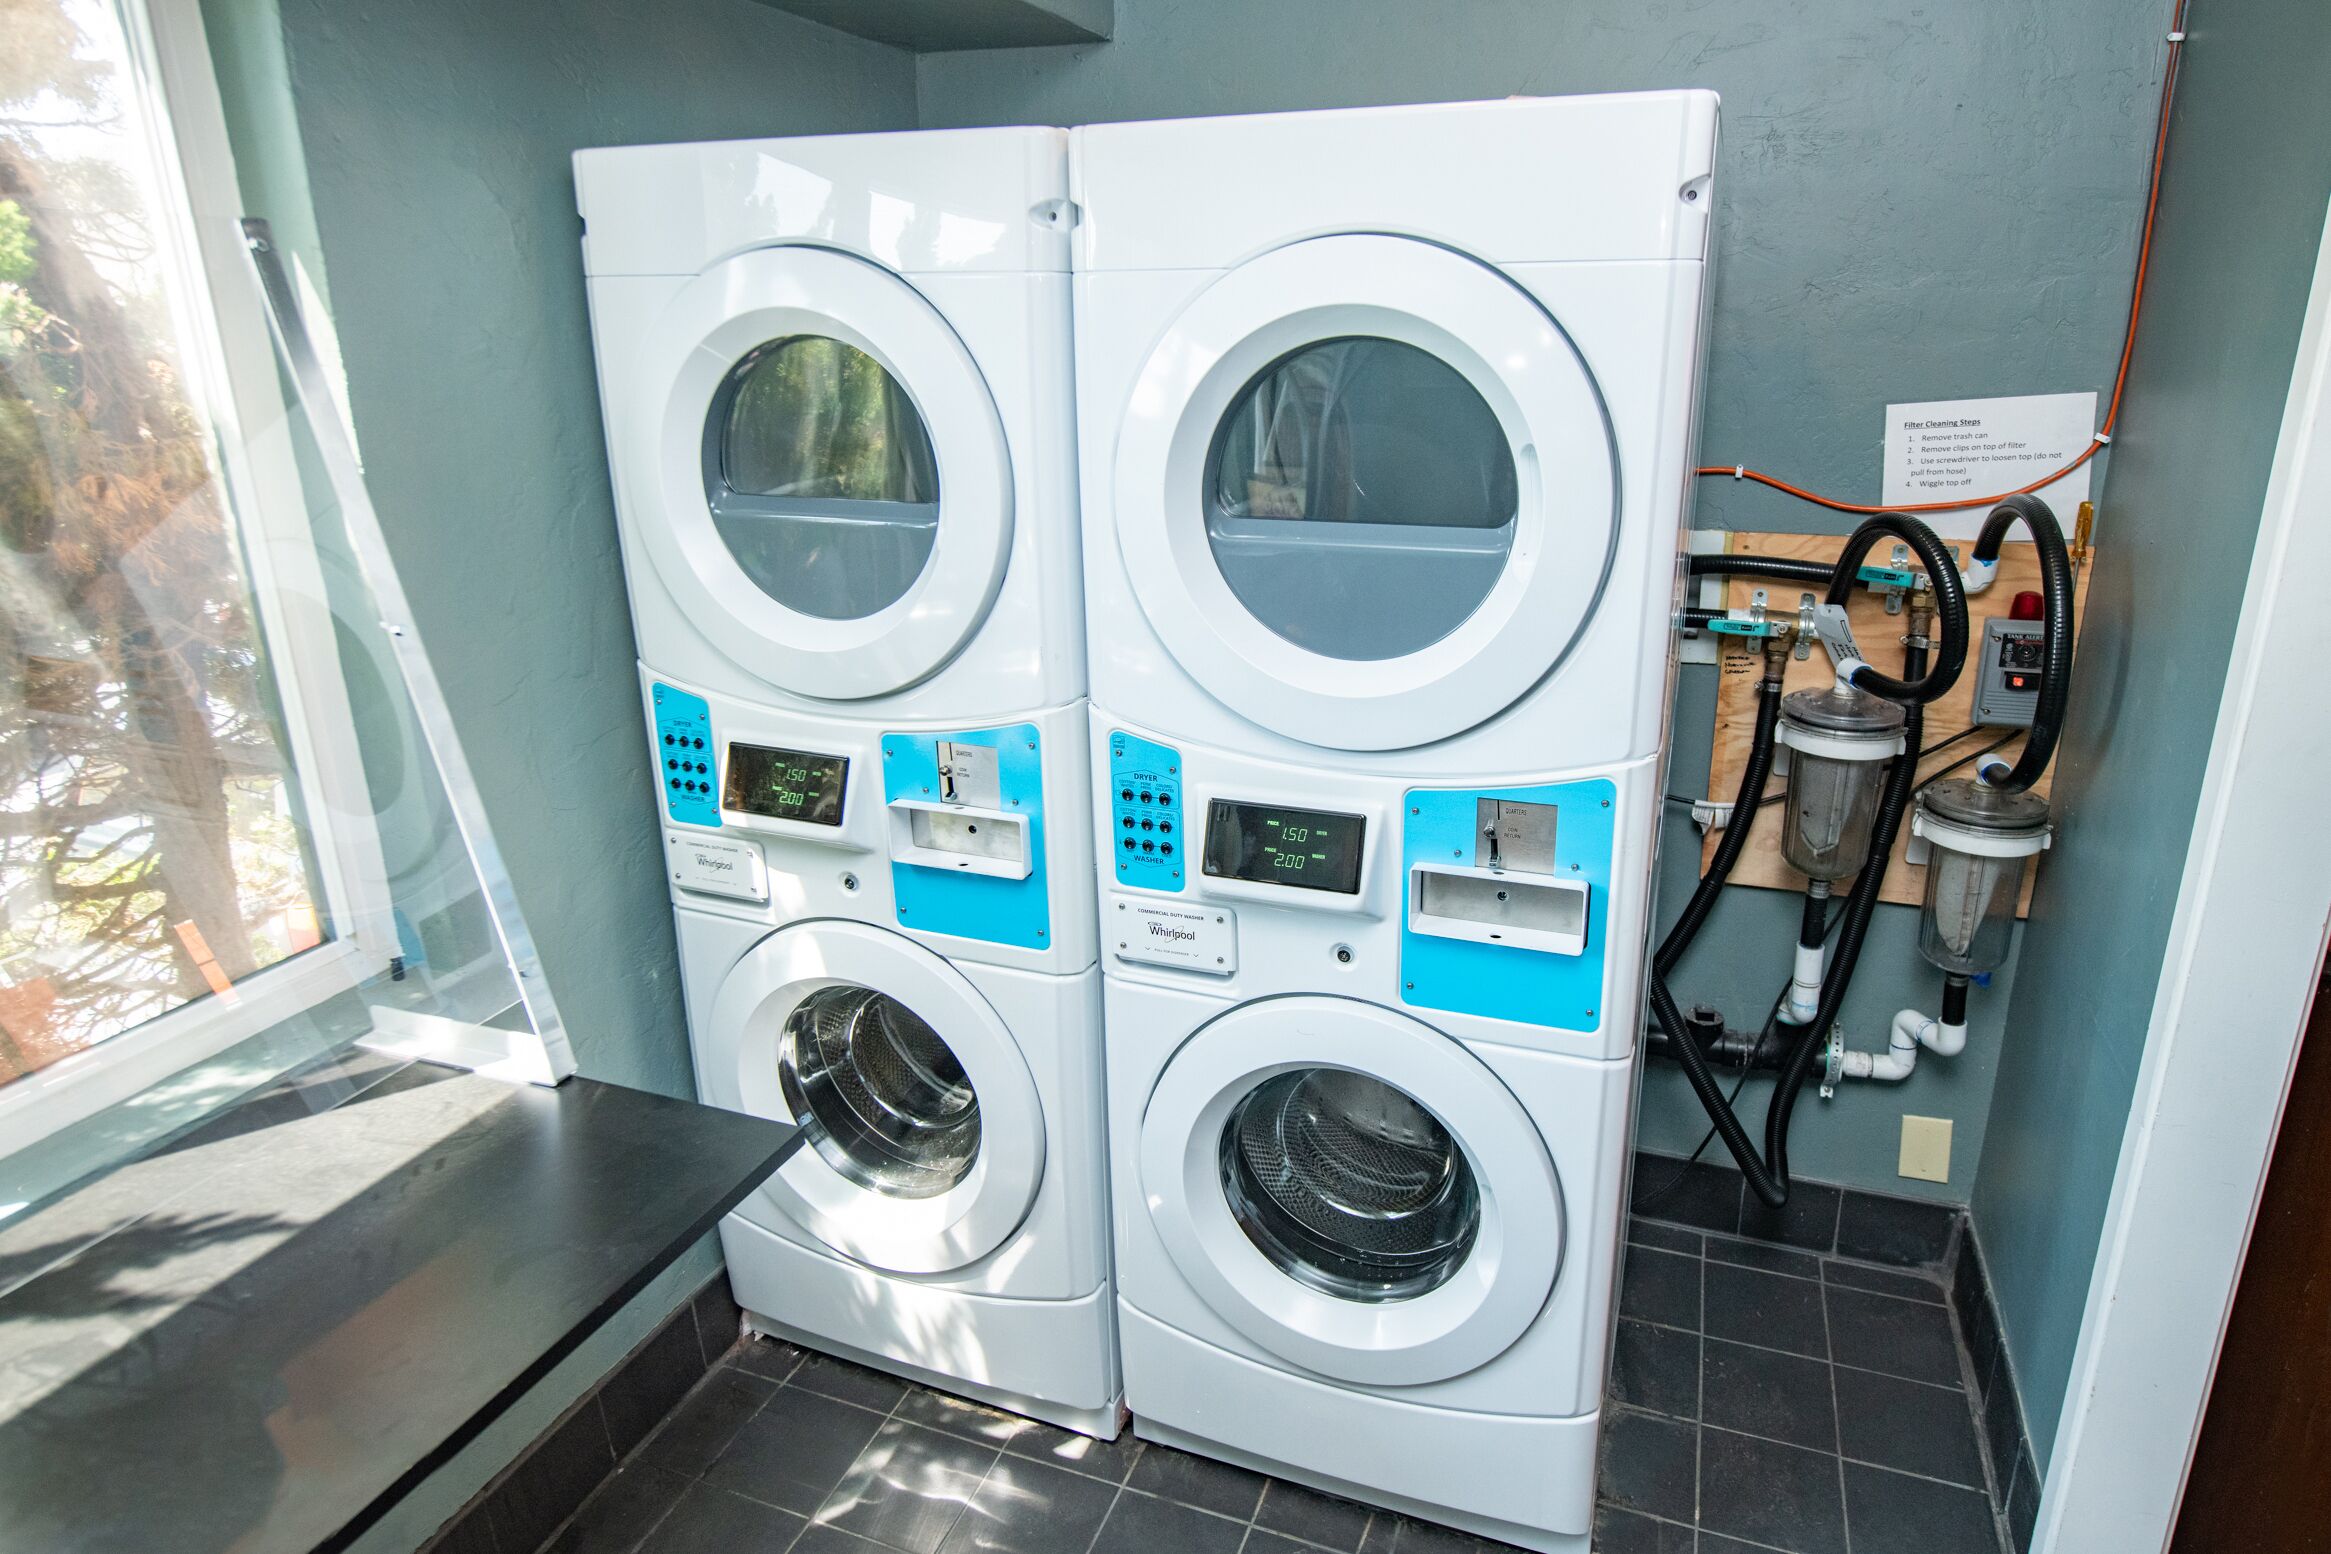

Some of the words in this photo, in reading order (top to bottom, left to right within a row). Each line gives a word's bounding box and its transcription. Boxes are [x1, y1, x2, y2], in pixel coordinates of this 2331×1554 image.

[1952, 444, 1970, 452] clips
[2033, 452, 2047, 460] (do
[1910, 469, 1925, 477] pull
[1946, 467, 1967, 475] hose)
[1919, 479, 1945, 488] Wiggle
[1960, 478, 1972, 486] off
[1133, 773, 1158, 782] DRYER
[1282, 827, 1308, 842] 1.50
[697, 857, 734, 871] Whirlpool
[1133, 854, 1165, 865] WASHER
[1274, 853, 1305, 869] 2.00
[1137, 908, 1169, 917] COMMERCIAL
[1149, 925, 1195, 941] Whirlpool
